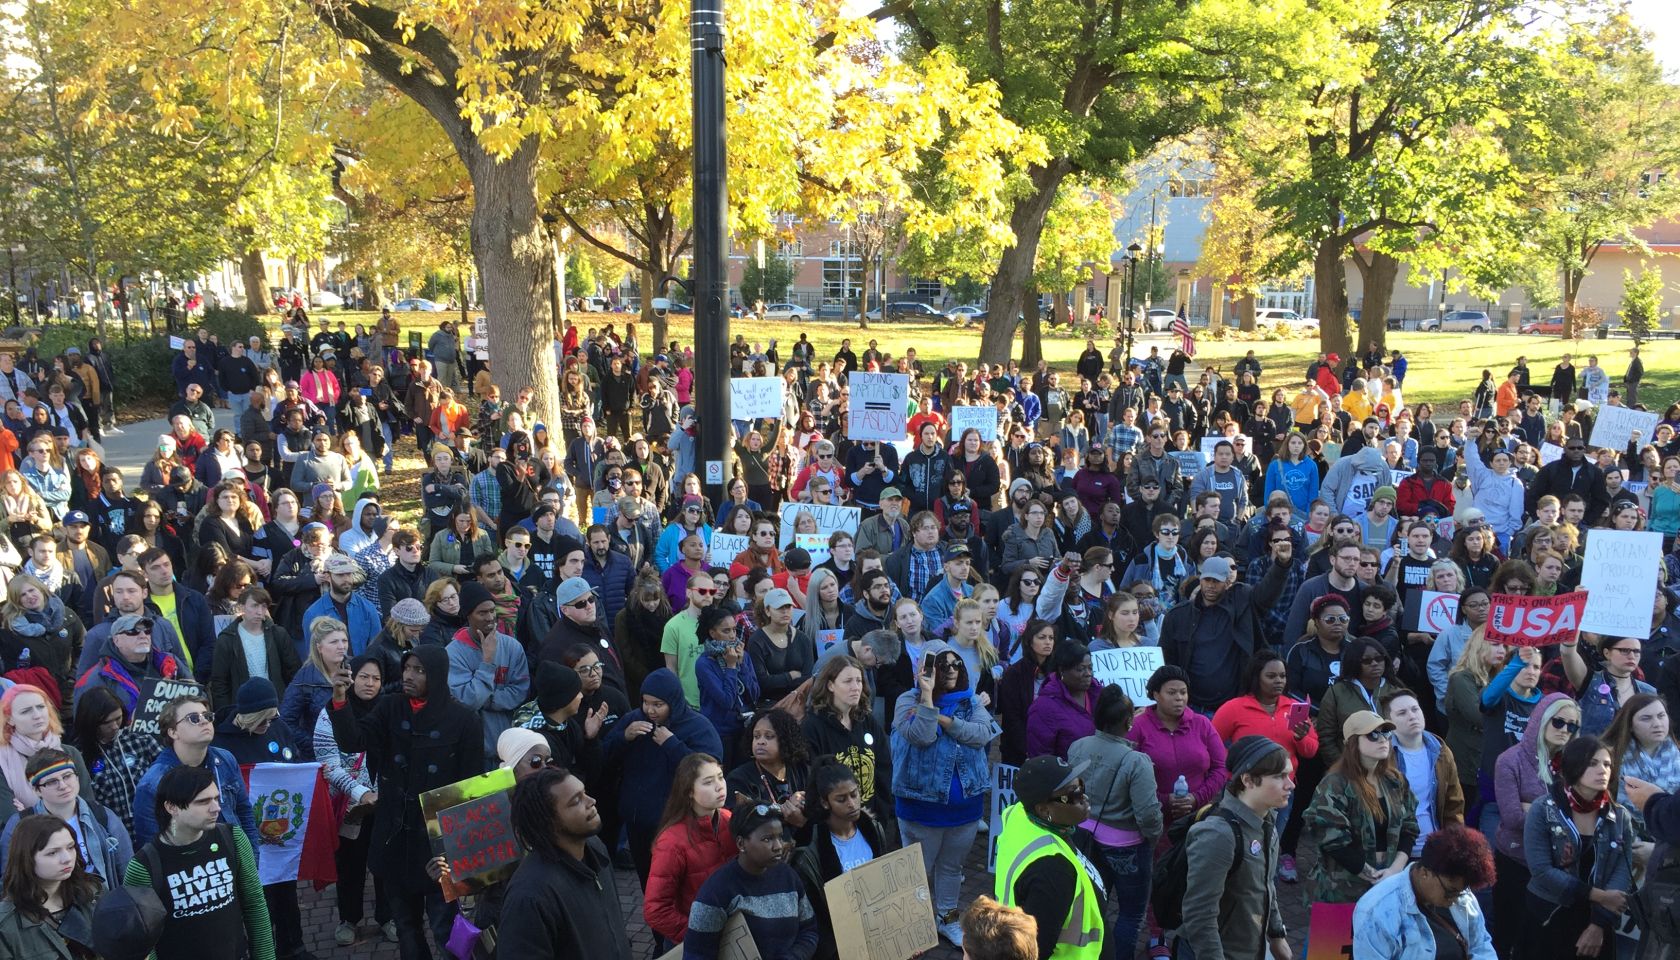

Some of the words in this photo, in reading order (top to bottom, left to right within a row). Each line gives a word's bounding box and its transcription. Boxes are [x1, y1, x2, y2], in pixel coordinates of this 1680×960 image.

[863, 373, 893, 385] DYING
[851, 410, 907, 434] FASCISM
[713, 534, 747, 551] BLACK
[1493, 595, 1514, 605] THIS
[1518, 597, 1528, 607] IS
[1531, 597, 1552, 608] OUR
[1604, 583, 1630, 594] AND
[1623, 597, 1636, 609] A
[1492, 604, 1576, 637] USA
[1122, 650, 1157, 672] RAPE
[441, 803, 503, 836] BLACK
[455, 820, 506, 850] LIVES
[166, 857, 230, 889] BLACK
[451, 839, 519, 878] MATTER
[170, 870, 234, 900] LIVES
[173, 882, 234, 910] MATTER
[844, 850, 923, 913] BLACK
[863, 897, 930, 935] LIVES
